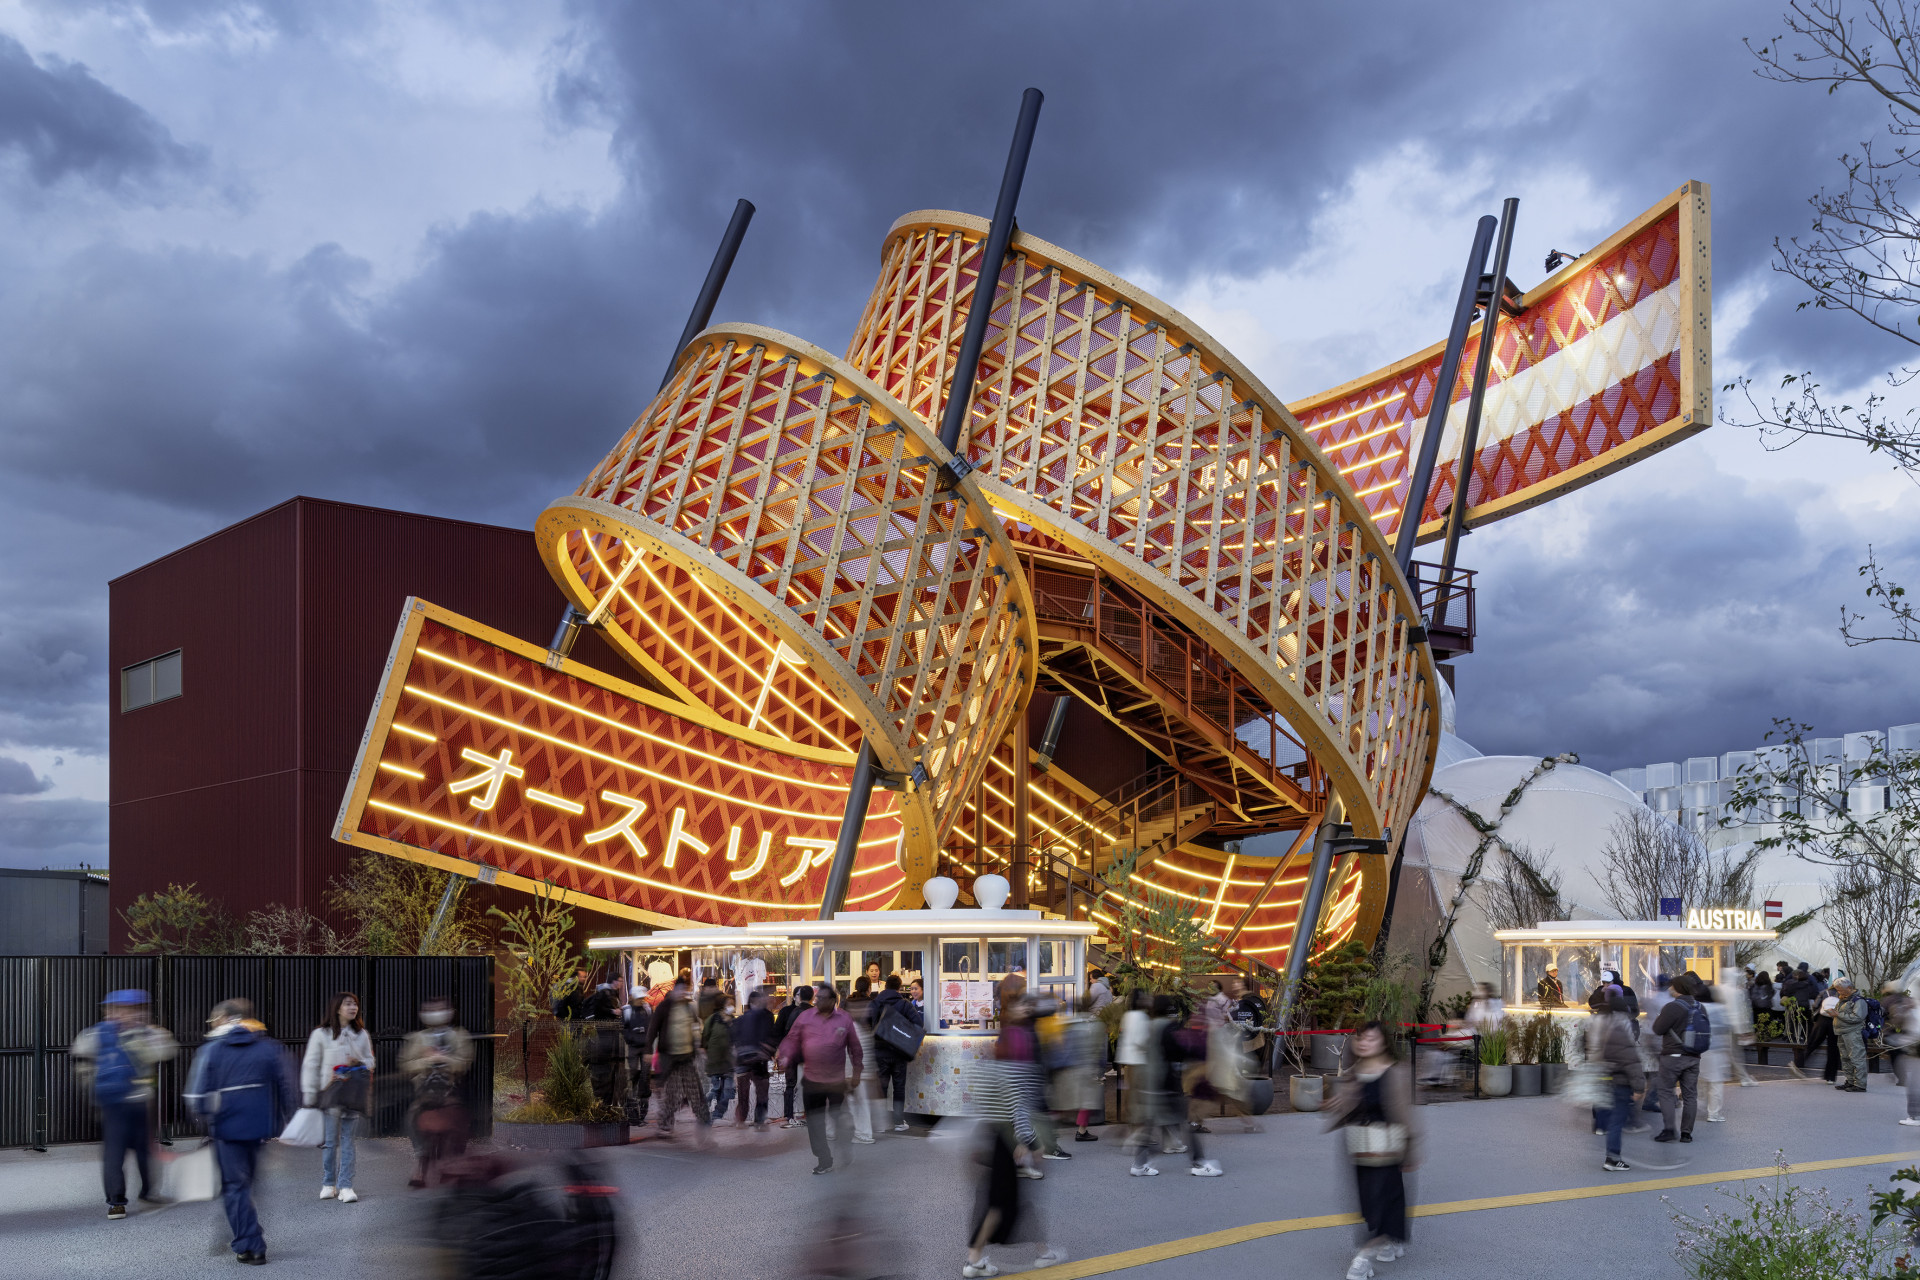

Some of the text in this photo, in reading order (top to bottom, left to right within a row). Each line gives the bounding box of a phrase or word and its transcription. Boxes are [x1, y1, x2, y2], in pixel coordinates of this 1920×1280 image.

[449, 748, 836, 887] オーストリア
[1687, 908, 1765, 930] AUSTRIA
